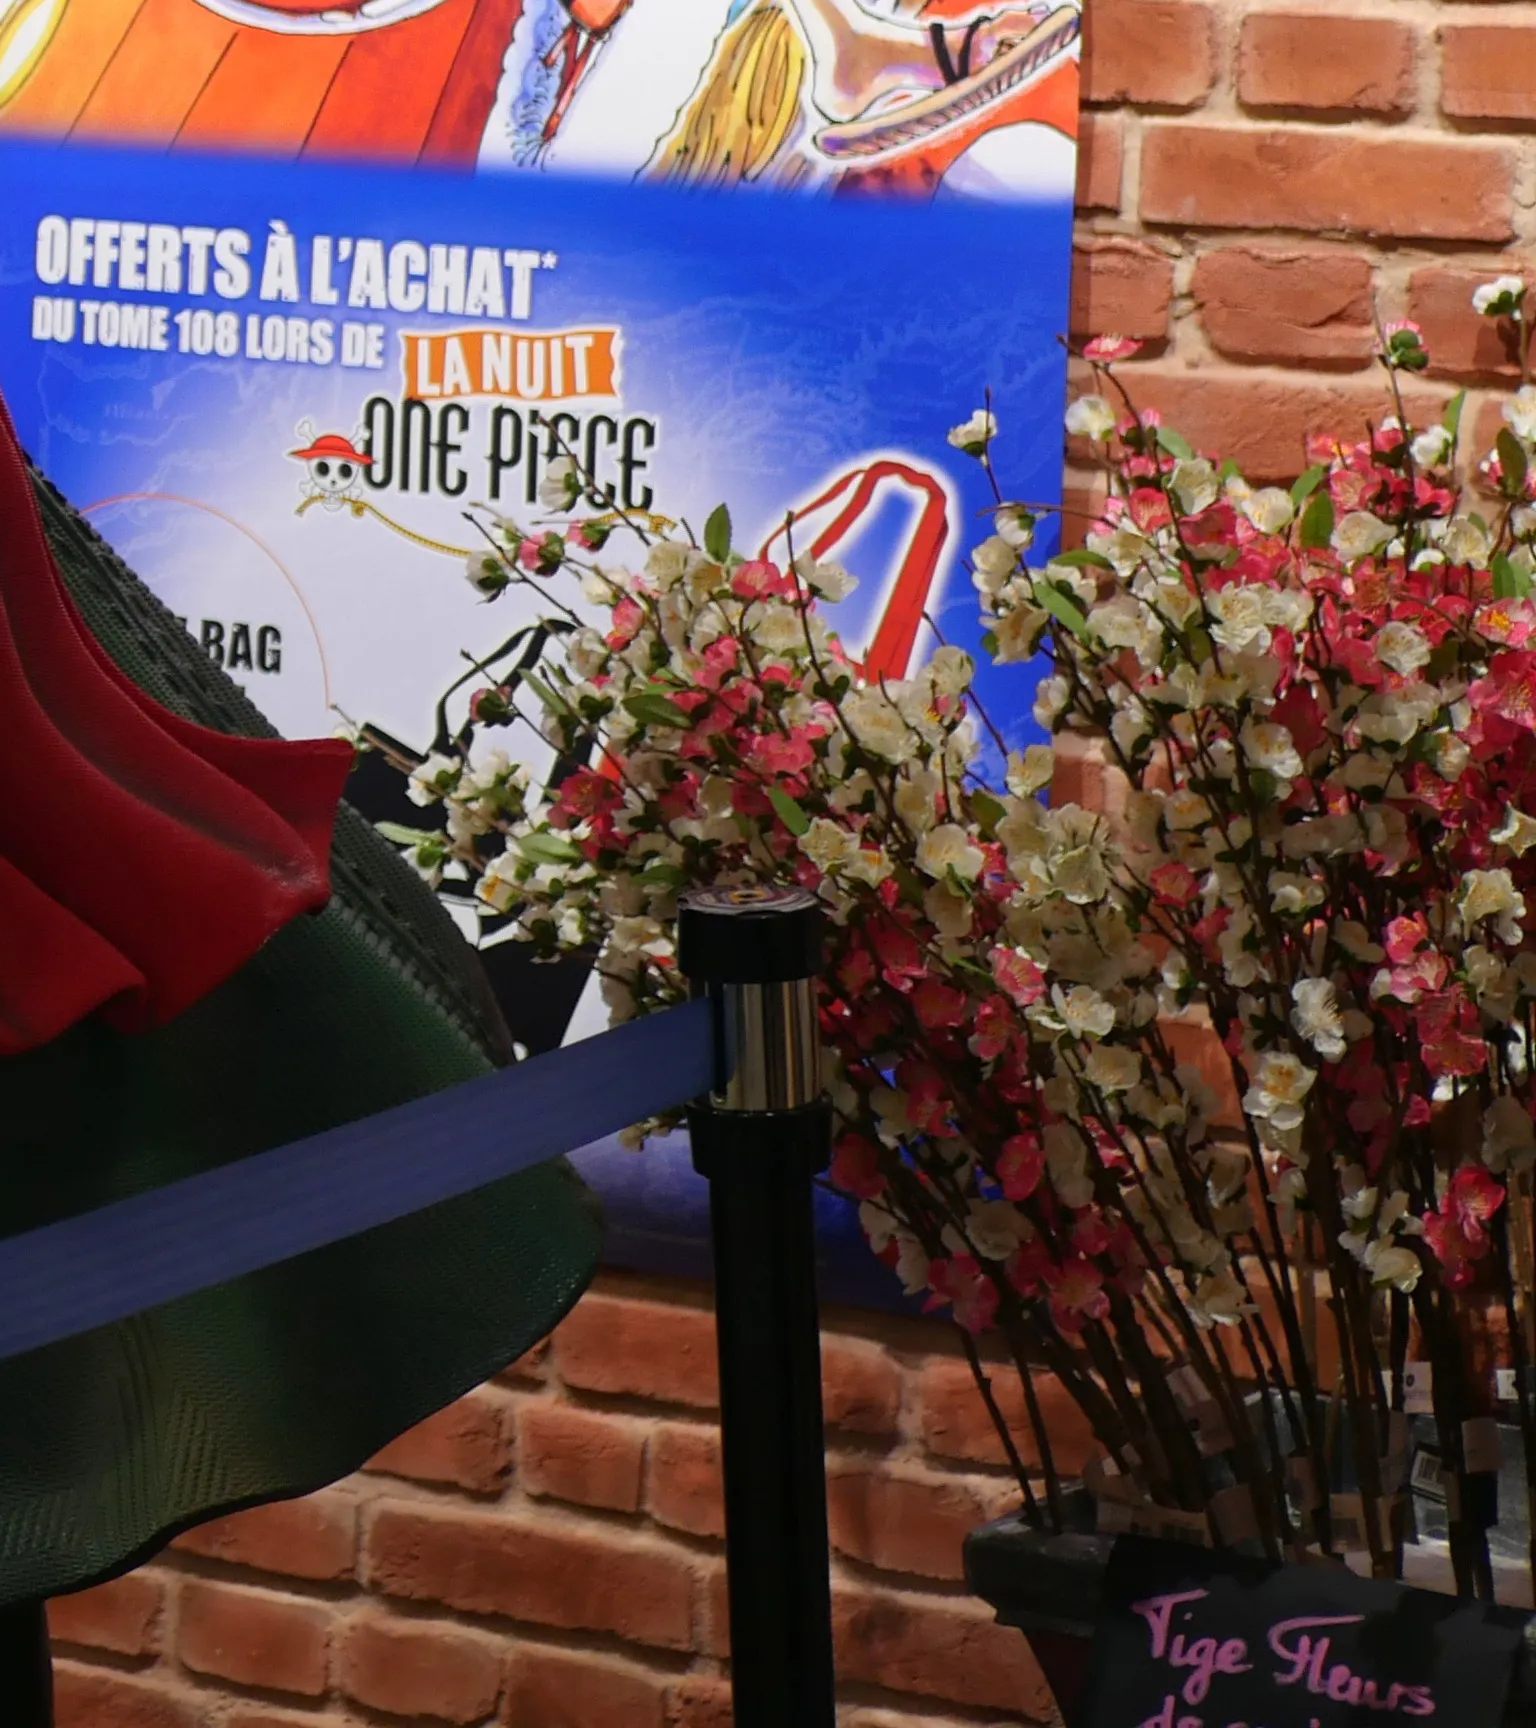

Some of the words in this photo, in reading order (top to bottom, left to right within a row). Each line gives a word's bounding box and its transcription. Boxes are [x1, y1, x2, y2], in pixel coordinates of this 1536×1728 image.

[35, 214, 251, 300] OFFERTS
[259, 219, 301, 303] À
[32, 296, 74, 343] DU
[80, 300, 169, 352] TOME
[174, 308, 240, 356] 108
[245, 313, 335, 366] LORS
[340, 322, 385, 369] DE
[416, 336, 472, 396] LA
[482, 333, 594, 398] NUIT
[363, 397, 469, 496] ONE
[200, 618, 282, 674] BAG
[1130, 1589, 1253, 1705] Tige
[1268, 1615, 1435, 1716] Fleurs
